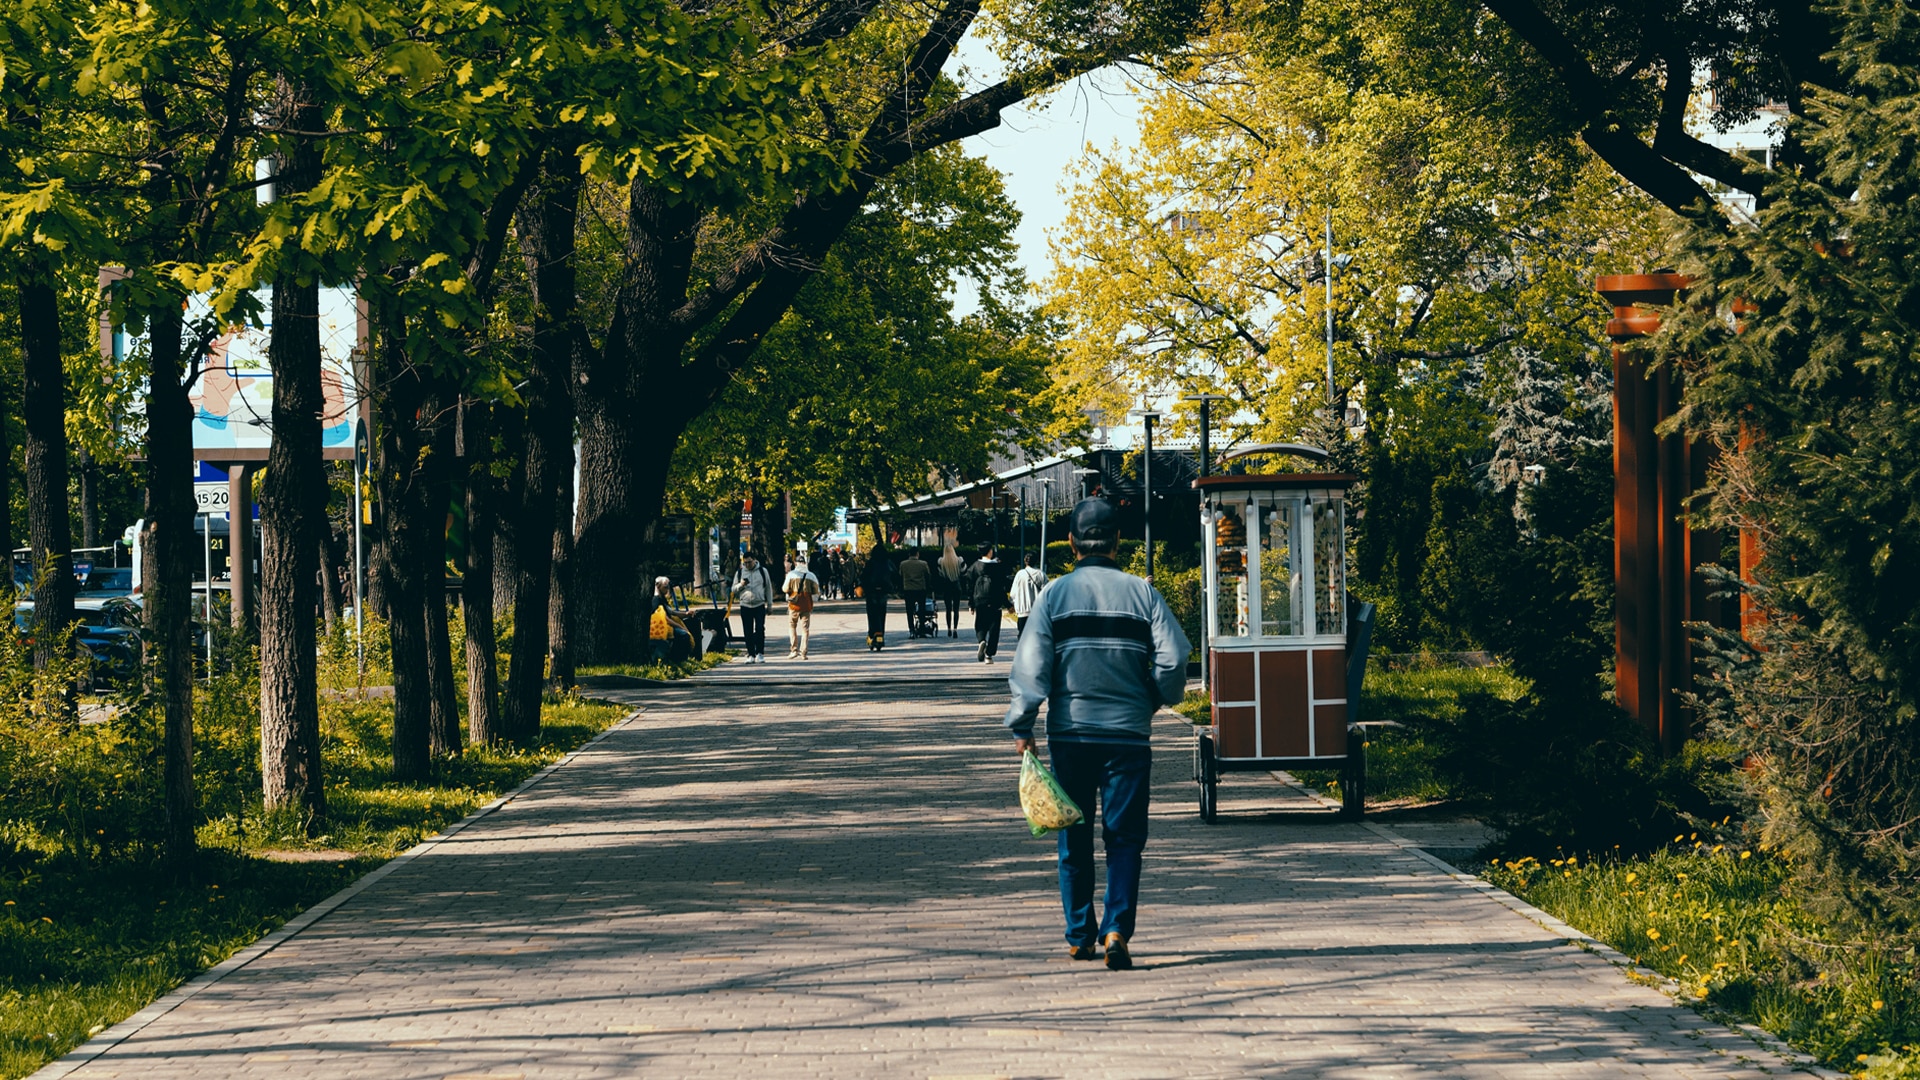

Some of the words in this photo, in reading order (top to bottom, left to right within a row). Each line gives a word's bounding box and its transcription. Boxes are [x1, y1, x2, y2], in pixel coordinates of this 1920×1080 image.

[198, 494, 209, 504] 15
[212, 492, 229, 504] 20
[211, 538, 223, 550] 21
